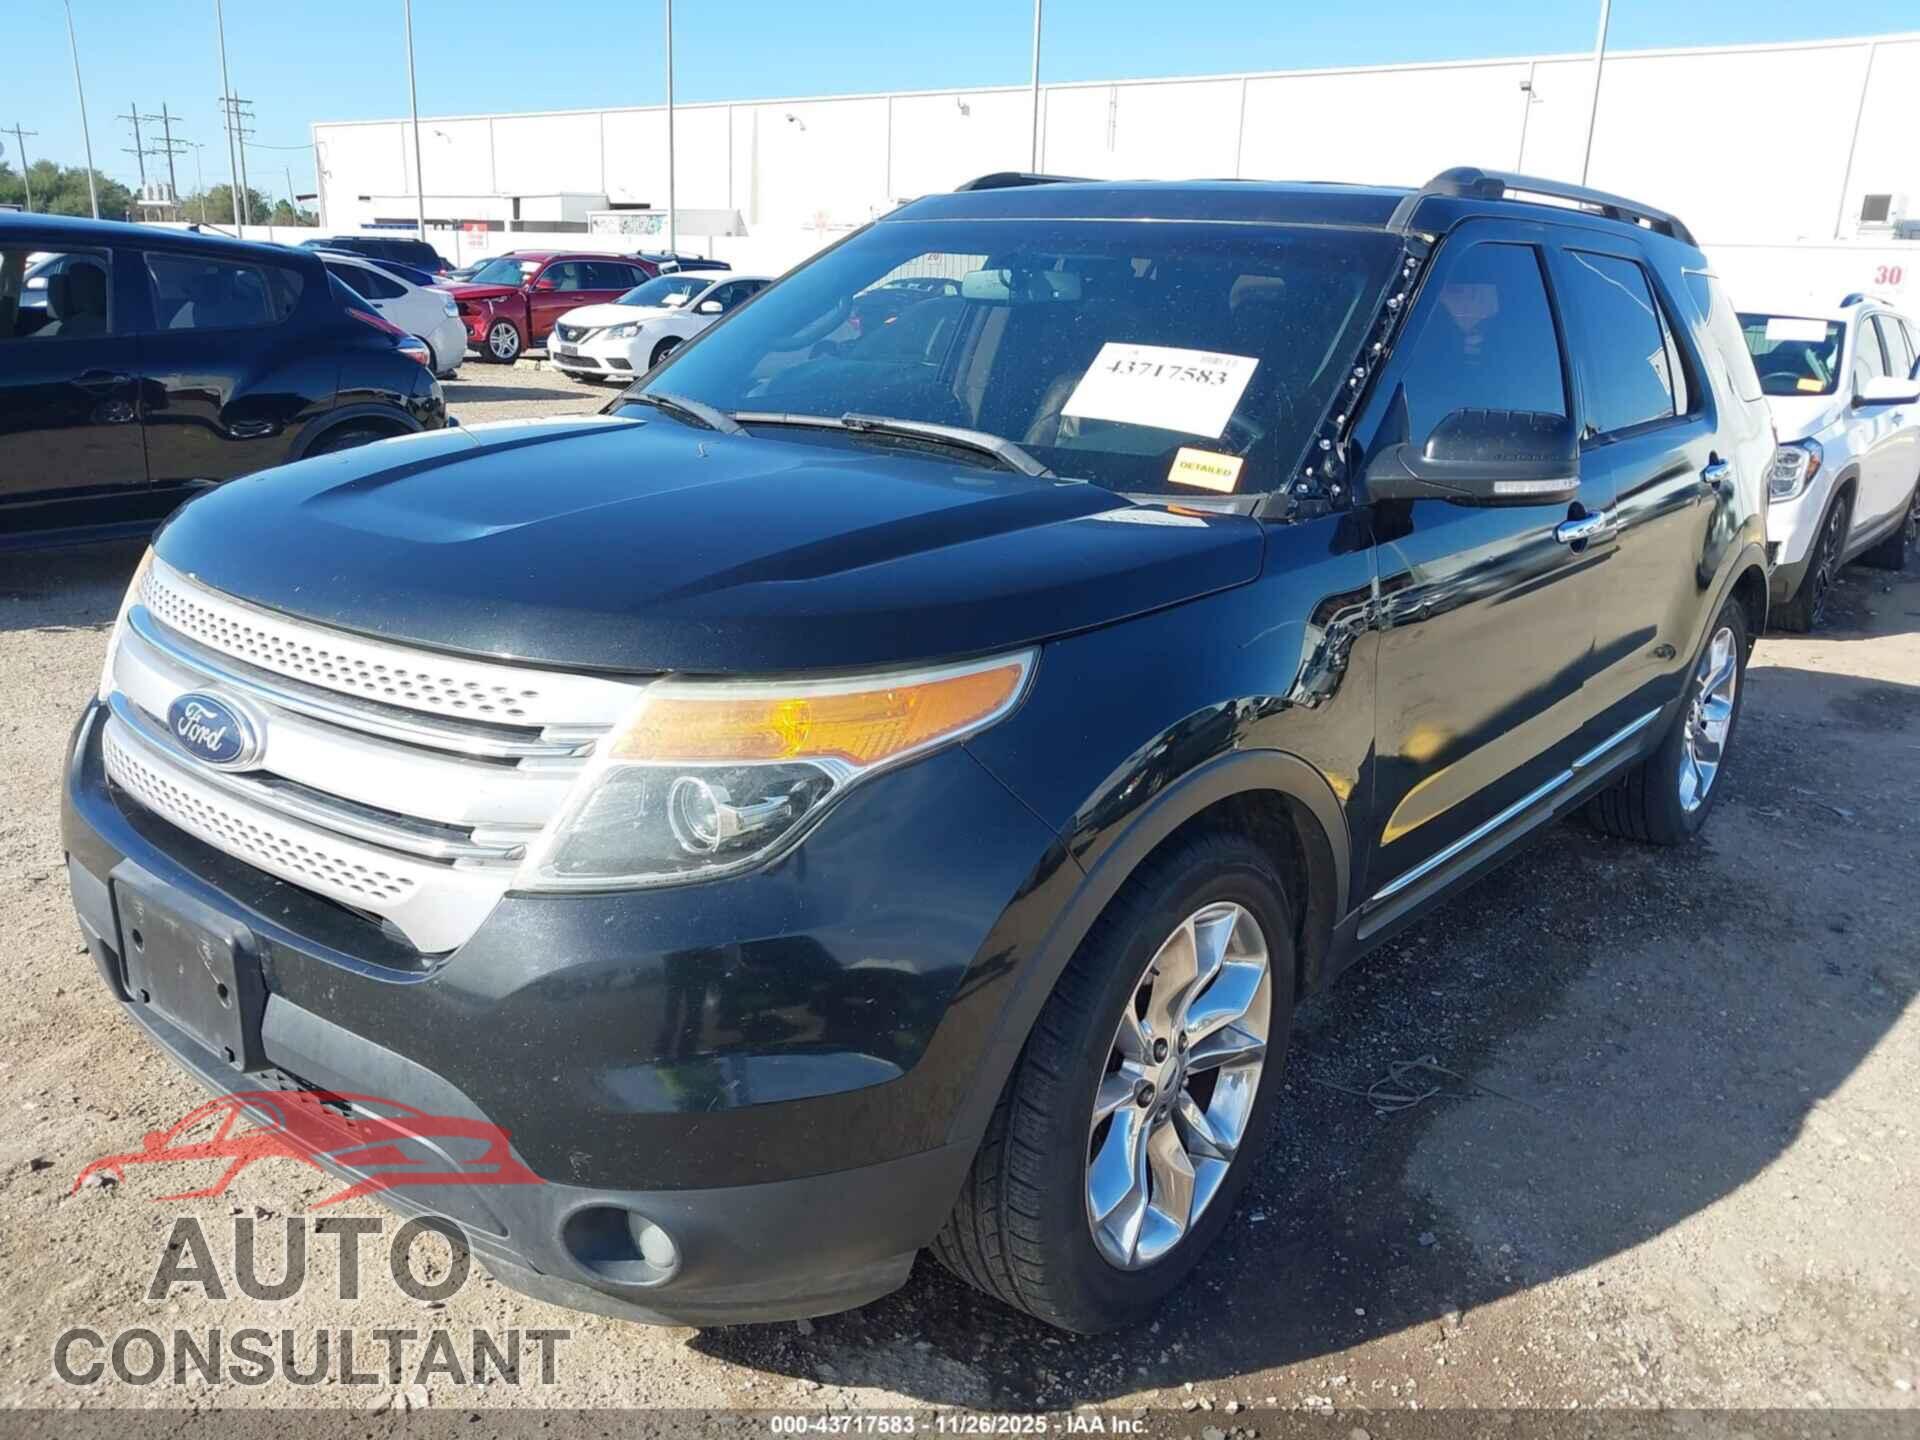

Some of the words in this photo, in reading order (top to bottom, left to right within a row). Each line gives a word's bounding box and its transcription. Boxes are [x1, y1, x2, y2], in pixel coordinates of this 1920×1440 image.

[1874, 264, 1903, 285] 30
[1106, 359, 1228, 386] 43717583
[1180, 461, 1233, 476] DETAILED
[177, 701, 228, 752] Ford
